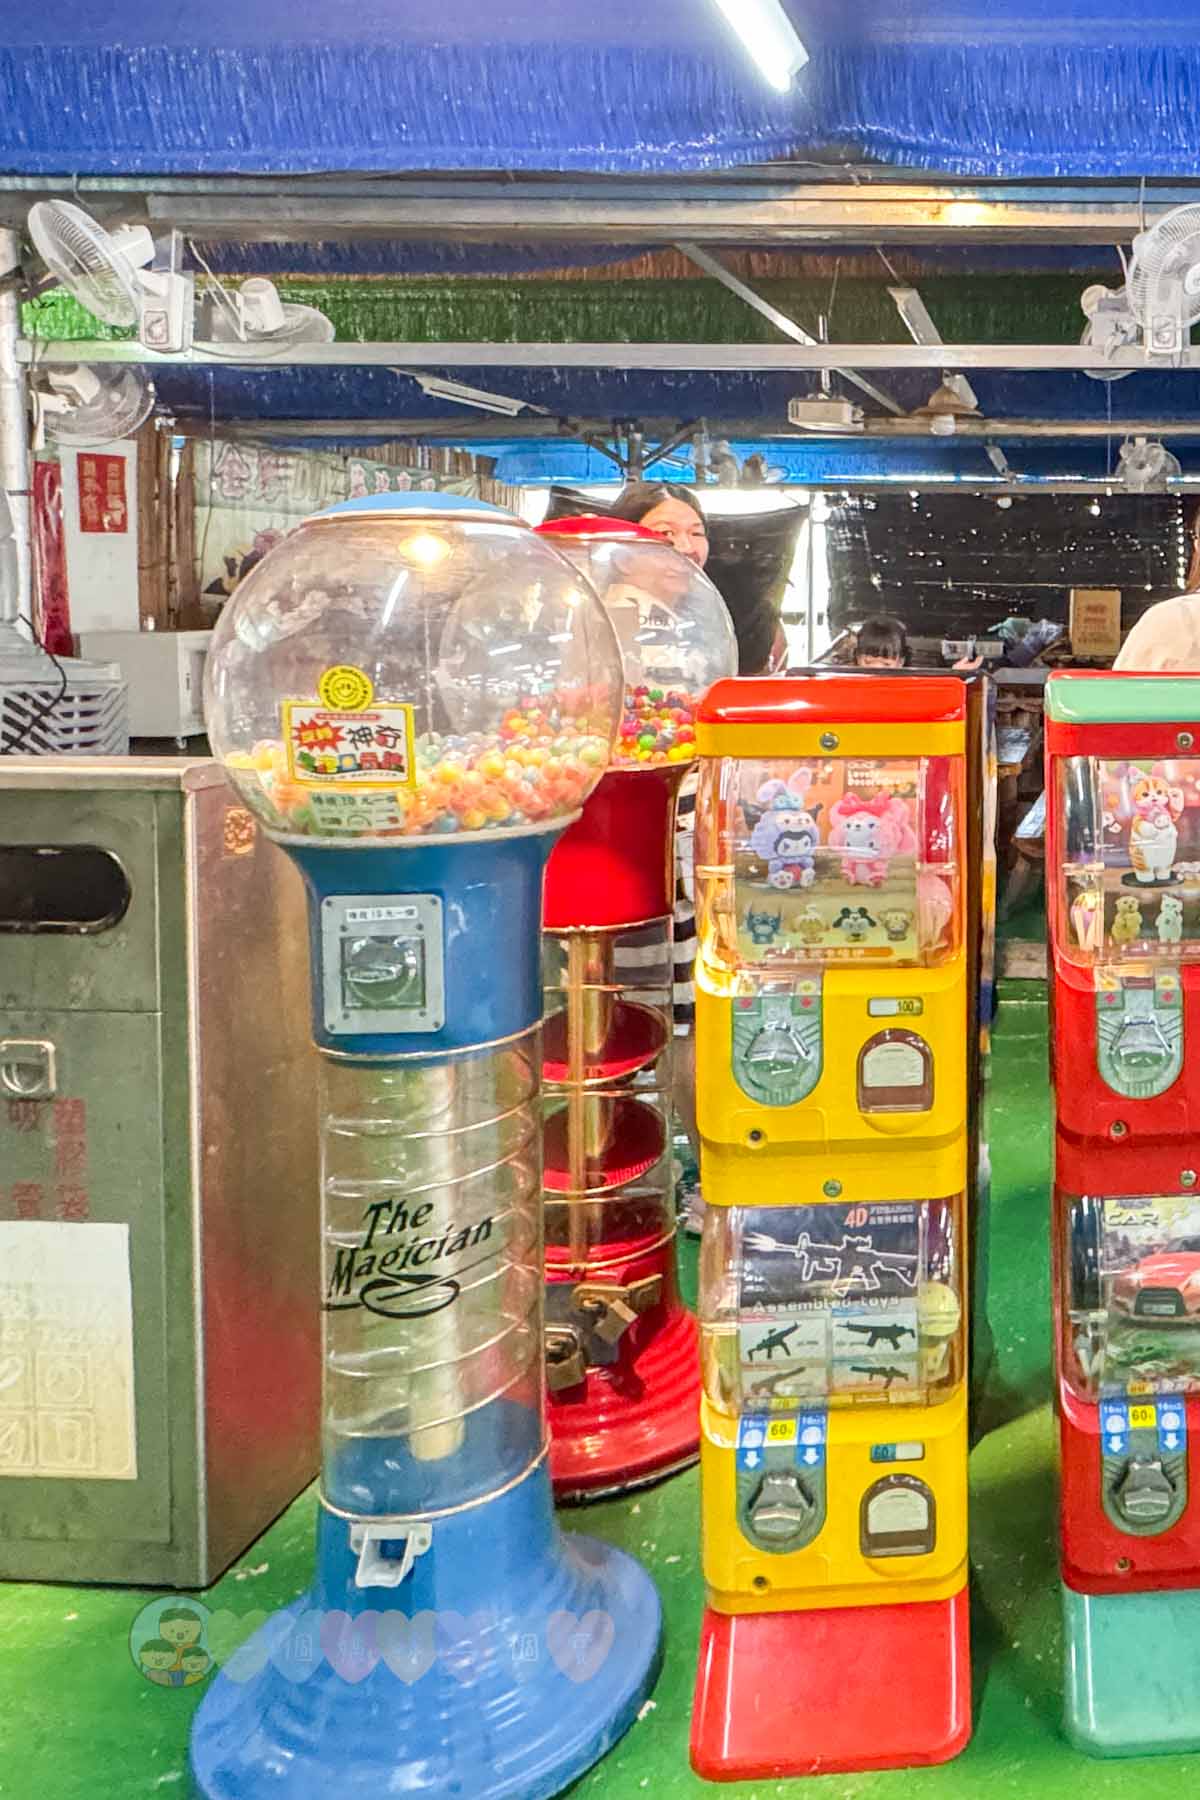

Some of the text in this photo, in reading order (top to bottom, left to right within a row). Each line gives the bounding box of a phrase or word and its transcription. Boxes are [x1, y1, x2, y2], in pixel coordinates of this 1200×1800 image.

[361, 1199, 435, 1250] The
[843, 1207, 868, 1229] 4D
[327, 1216, 494, 1298] Magician
[751, 1297, 852, 1314] Assembled
